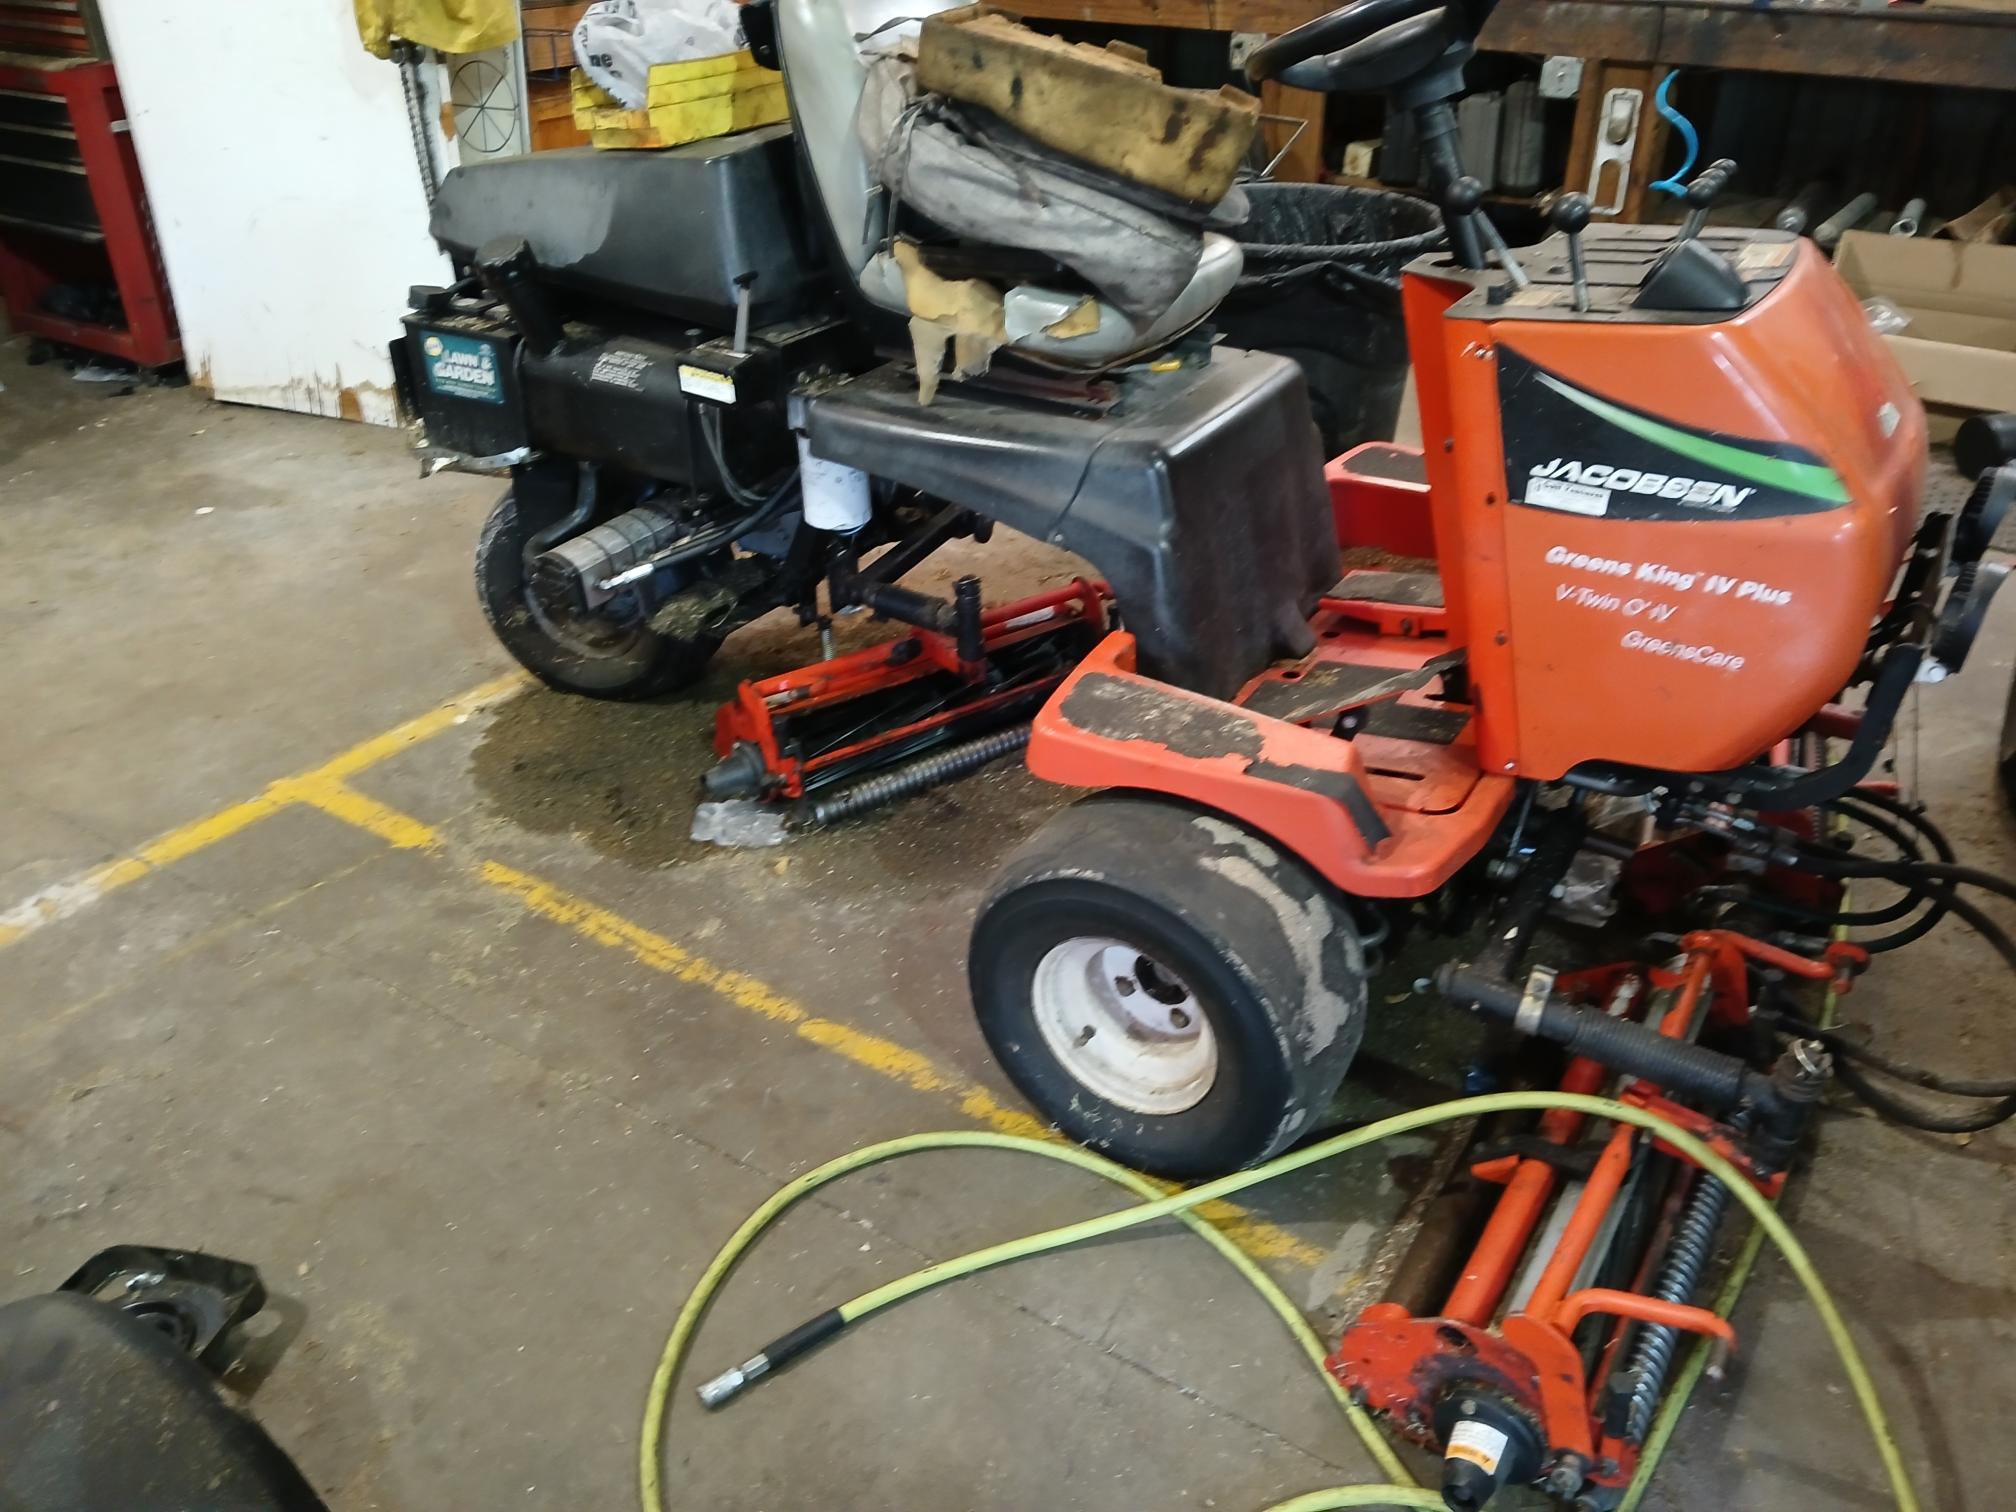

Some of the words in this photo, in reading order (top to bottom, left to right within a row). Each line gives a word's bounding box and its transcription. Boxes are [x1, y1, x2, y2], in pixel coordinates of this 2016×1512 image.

[432, 361, 495, 386] GARDEN
[440, 349, 479, 368] LAWN
[480, 356, 493, 369] &
[1529, 457, 1753, 508] JACOBSEN
[1545, 545, 1632, 577] Greens
[1634, 562, 1697, 591] King
[1703, 574, 1738, 595] IV
[1735, 580, 1793, 607] Plus
[1556, 583, 1620, 612] V-Twin
[1620, 630, 1745, 671] GreensCare
